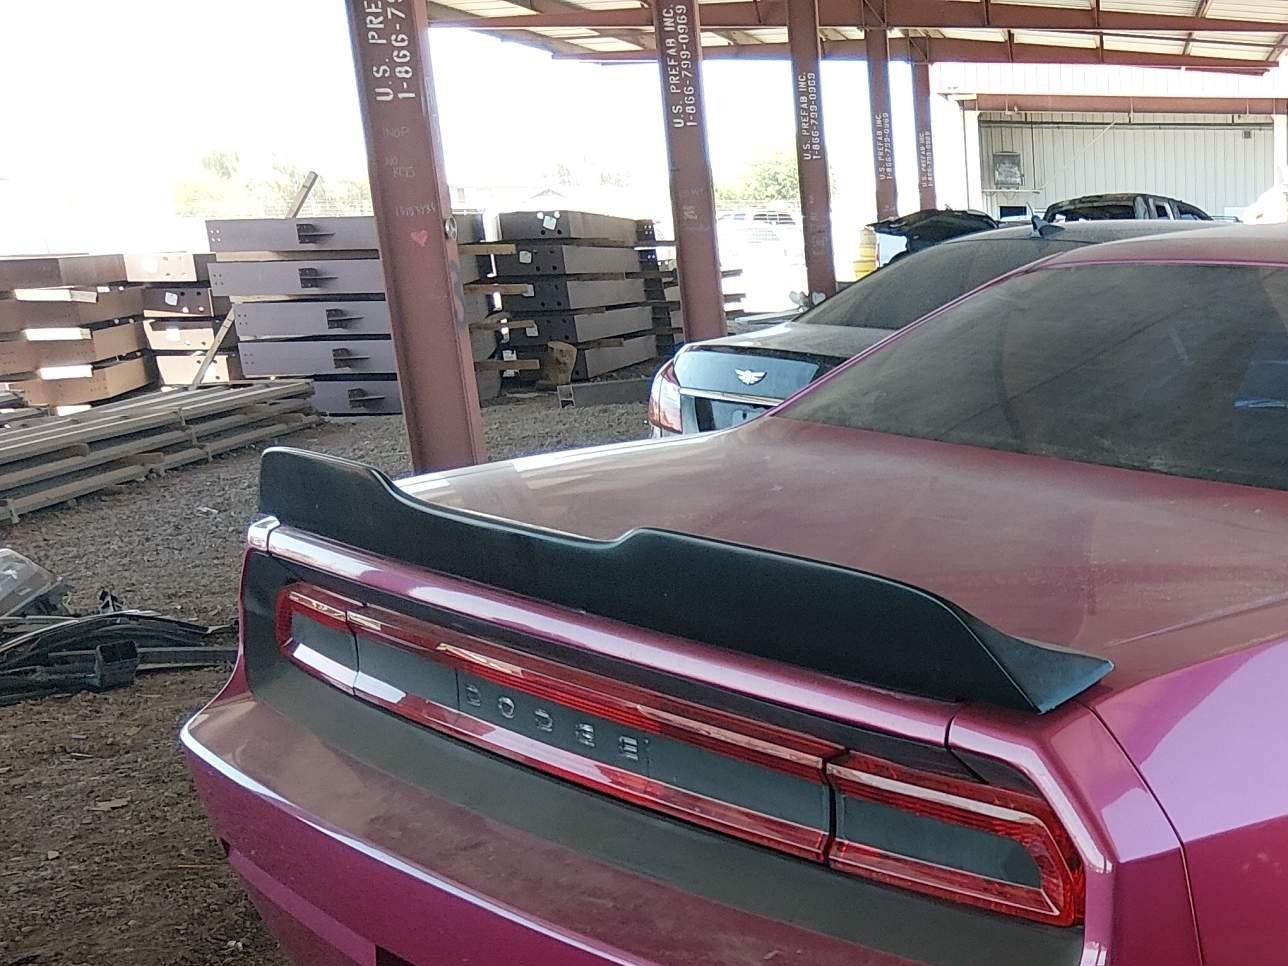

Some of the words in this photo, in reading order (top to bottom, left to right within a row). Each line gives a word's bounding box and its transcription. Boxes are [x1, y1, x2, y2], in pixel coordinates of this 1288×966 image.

[662, 4, 676, 31] INC.
[387, 0, 417, 99] 1-866-7
[664, 38, 682, 93] PREFAB
[674, 4, 698, 127] 1-866-799-0969
[372, 58, 395, 101] U.S.
[798, 72, 807, 92] INC.
[671, 100, 685, 128] U.S.
[799, 95, 811, 136] PREFAB
[802, 139, 812, 160] U.S.
[464, 683, 640, 761] DODGE
